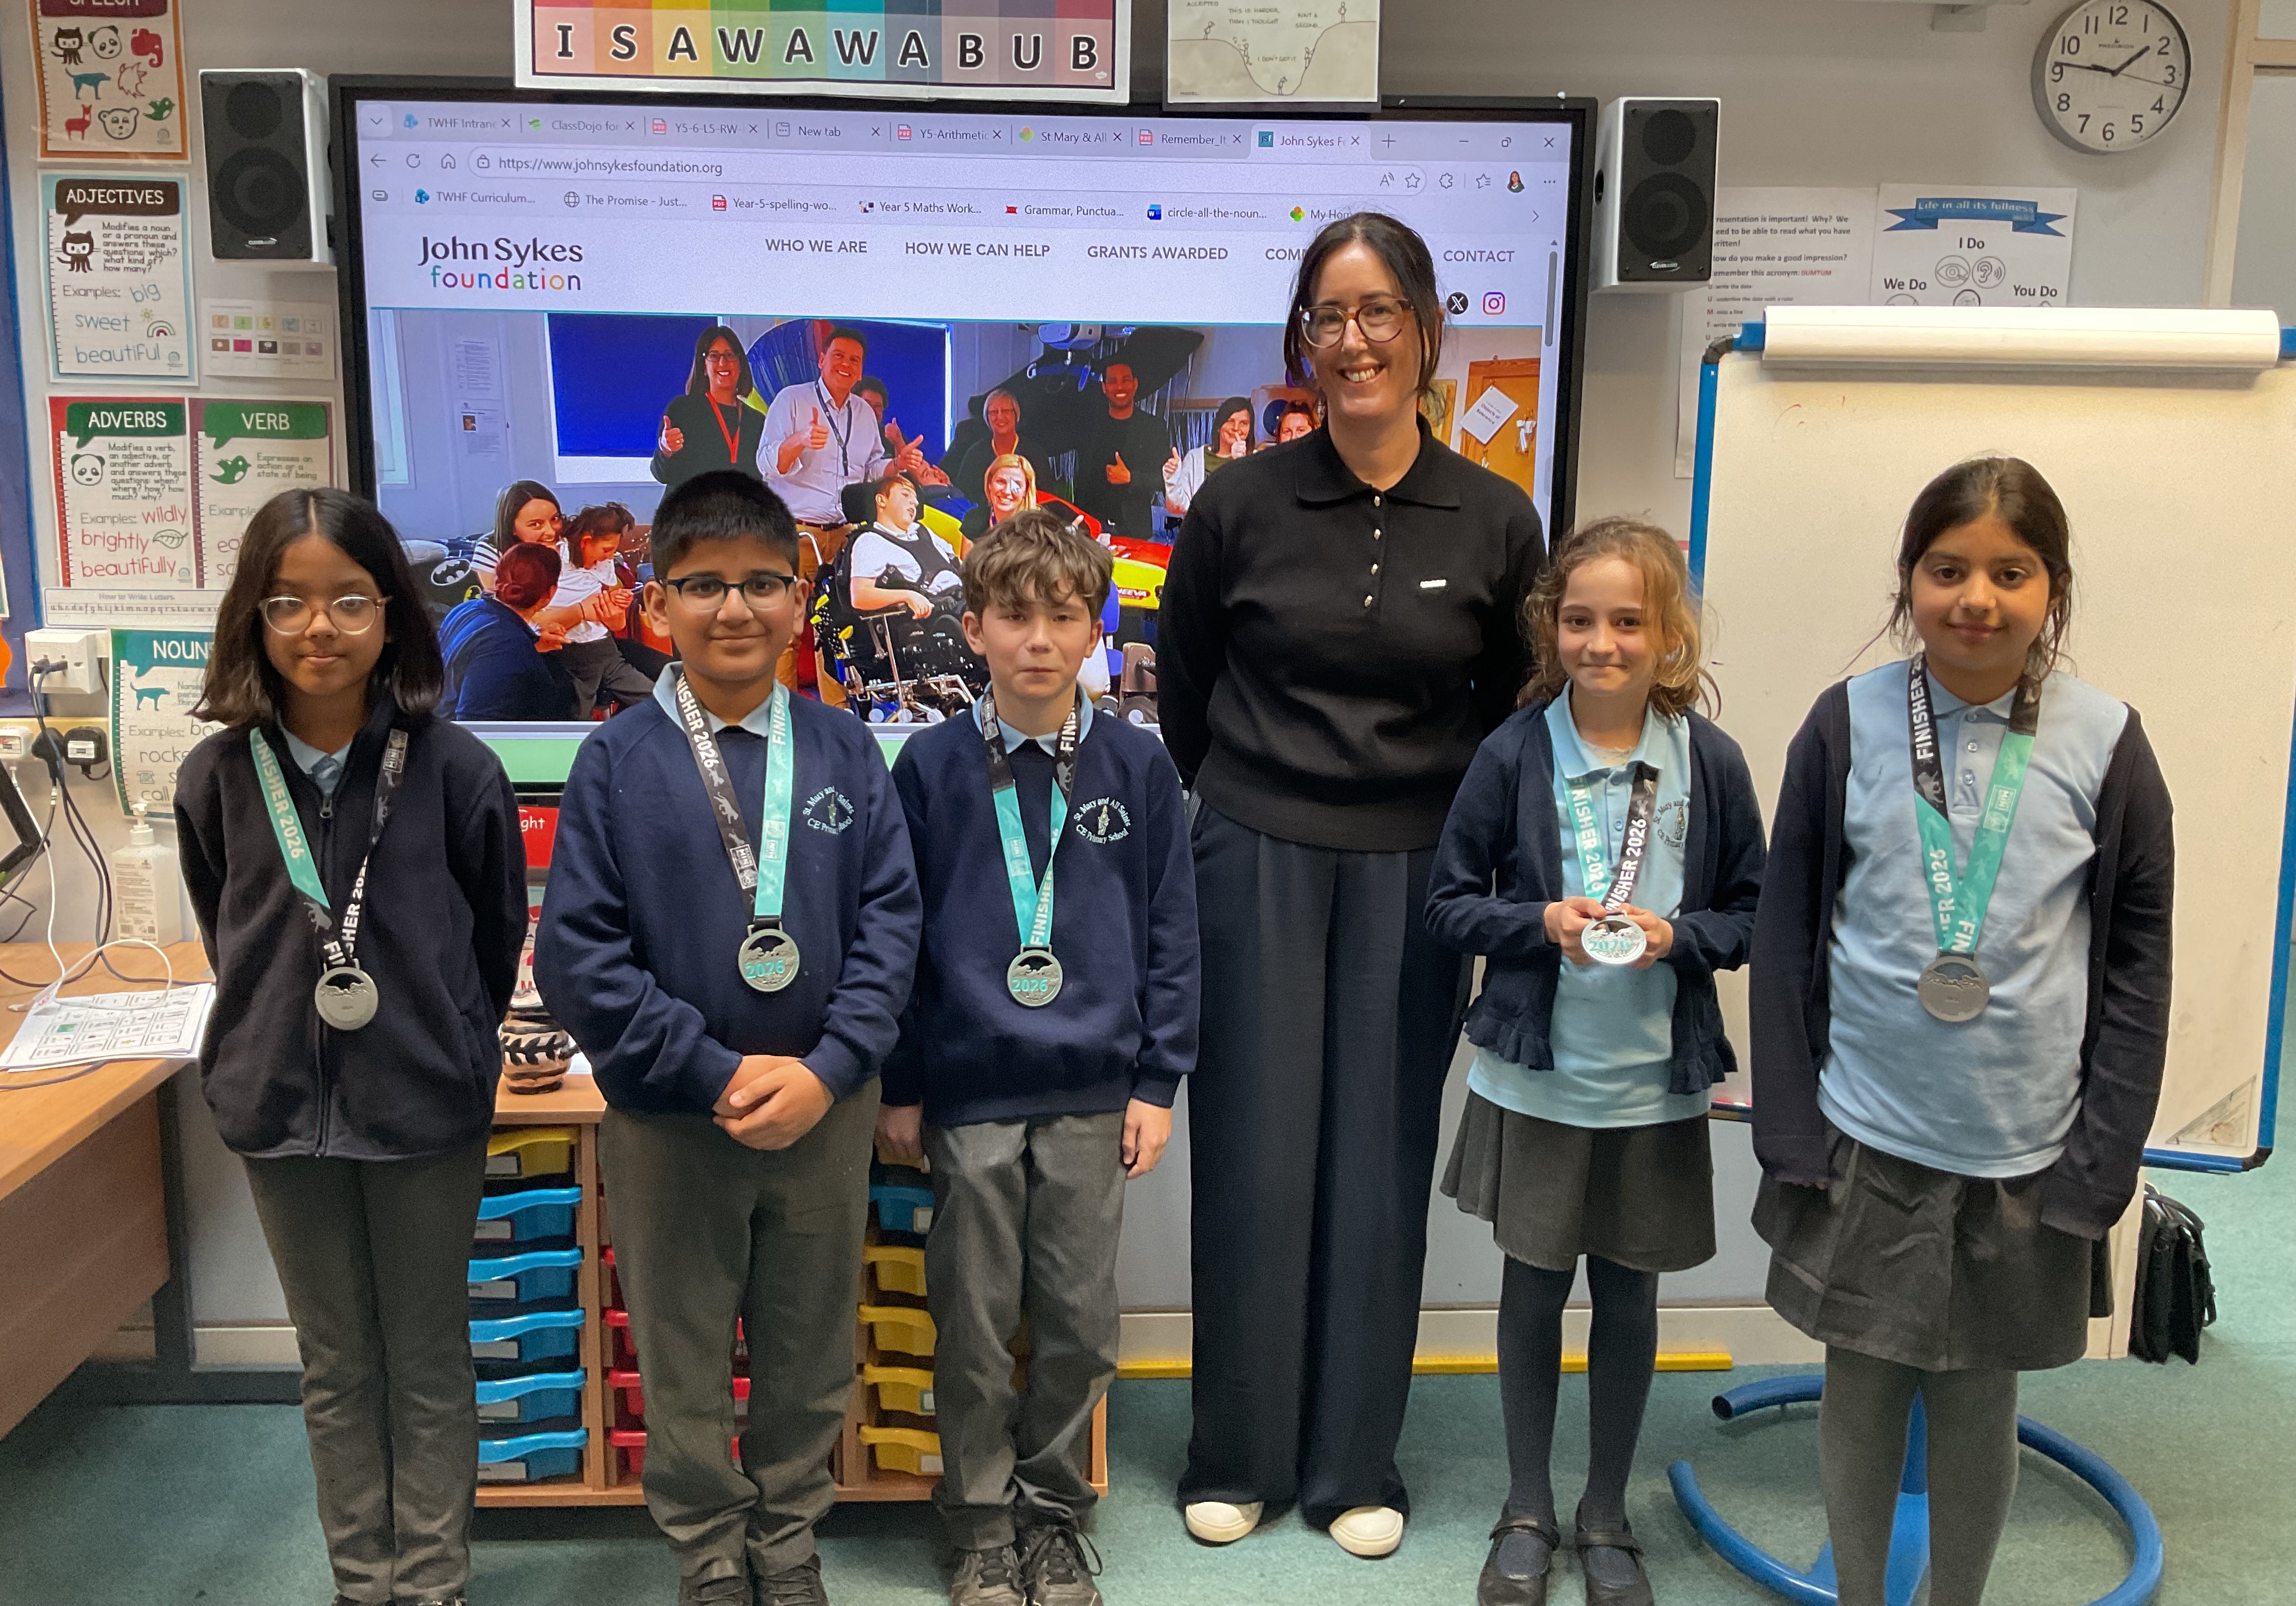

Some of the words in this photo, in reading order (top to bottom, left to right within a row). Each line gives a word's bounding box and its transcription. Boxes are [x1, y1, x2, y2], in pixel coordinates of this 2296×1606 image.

[2109, 6, 2128, 25] 12
[2143, 14, 2148, 33] 1
[2085, 16, 2099, 34] 11
[557, 26, 573, 57] I
[611, 26, 636, 60] S
[669, 27, 698, 62] A
[719, 28, 763, 62] W
[785, 27, 813, 64] A
[835, 30, 878, 65] W
[899, 32, 928, 67] A
[959, 34, 984, 68] B
[1015, 35, 1041, 70] U
[1073, 36, 1097, 70] B
[2061, 35, 2080, 55] 10
[2158, 37, 2170, 55] 2
[2051, 64, 2063, 82] 9
[2163, 65, 2175, 84] 3
[2057, 93, 2071, 112] 8
[2150, 94, 2163, 114] 4
[428, 118, 458, 128] TWHF
[552, 120, 602, 133] ClassDojo
[799, 126, 821, 136] New
[825, 126, 841, 137] tab
[2078, 114, 2091, 133] 7
[2103, 123, 2115, 141] 6
[2131, 115, 2143, 133] 5
[1042, 132, 1051, 141] St
[1055, 132, 1079, 144] Mary
[1083, 133, 1091, 143] &
[1094, 132, 1106, 143] All
[1281, 136, 1304, 147] John
[1307, 136, 1334, 148] Sykes
[499, 157, 722, 176] https://www.johnsykesfoundation.org
[66, 189, 164, 205] ADJECTIVES
[437, 192, 467, 201] TWHF
[586, 195, 604, 205] The
[608, 196, 648, 206] Promise
[880, 202, 900, 212] Year
[904, 203, 910, 212] 5
[914, 203, 943, 213] Maths
[1025, 205, 1072, 216] Grammar,
[1311, 209, 1326, 221] My
[1329, 210, 1351, 219] Hom
[1769, 216, 1808, 224] important!
[1812, 216, 1832, 224] Why?
[418, 236, 488, 266] John
[494, 237, 583, 267] Sykes
[766, 239, 804, 252] WHO
[809, 239, 833, 252] WE
[838, 240, 868, 253] ARE
[905, 243, 943, 255] HOW
[948, 244, 971, 255] WE
[976, 244, 1008, 256] CAN
[1014, 245, 1050, 256] HELP
[1087, 246, 1147, 259] GRANTS
[1152, 247, 1228, 259] AWARDED
[1959, 238, 1962, 248] I
[1968, 238, 1985, 249] Do
[1265, 248, 1305, 260] COM
[1443, 250, 1514, 263] CONTACT
[1804, 254, 1847, 262] impression?
[430, 265, 581, 291] foundation
[1884, 278, 1905, 290] We
[1910, 279, 1926, 290] Do
[63, 285, 120, 299] Examples:
[129, 284, 161, 303] big
[2013, 285, 2036, 296] You
[2040, 286, 2057, 297] Do
[76, 315, 130, 331] sweet
[76, 343, 160, 363] beautiful
[89, 411, 167, 428] ADVERBS
[242, 412, 290, 430] VERB
[81, 513, 136, 526] Examples:
[142, 505, 187, 525] wildly
[82, 528, 149, 555] brightly
[81, 556, 176, 577] beautifully
[1910, 675, 1934, 760] FINISHER
[129, 725, 184, 741] Examples:
[140, 747, 189, 763] rocke
[694, 731, 719, 768] 2026
[141, 786, 170, 801] call
[256, 742, 289, 814] INISHER
[280, 815, 304, 858] 2026
[1079, 800, 1096, 813] Mary
[1098, 797, 1109, 805] and
[1110, 800, 1120, 809] All
[1118, 805, 1131, 826] Saints
[521, 816, 545, 832] ght
[1076, 824, 1087, 836] CE
[1108, 828, 1129, 841] School
[1626, 818, 1646, 857] 2026
[1586, 853, 1606, 891] 2026
[1930, 849, 1952, 893] 2026
[1951, 920, 1976, 953] FIN
[745, 959, 785, 979] 2026
[1012, 979, 1048, 992] 2026
